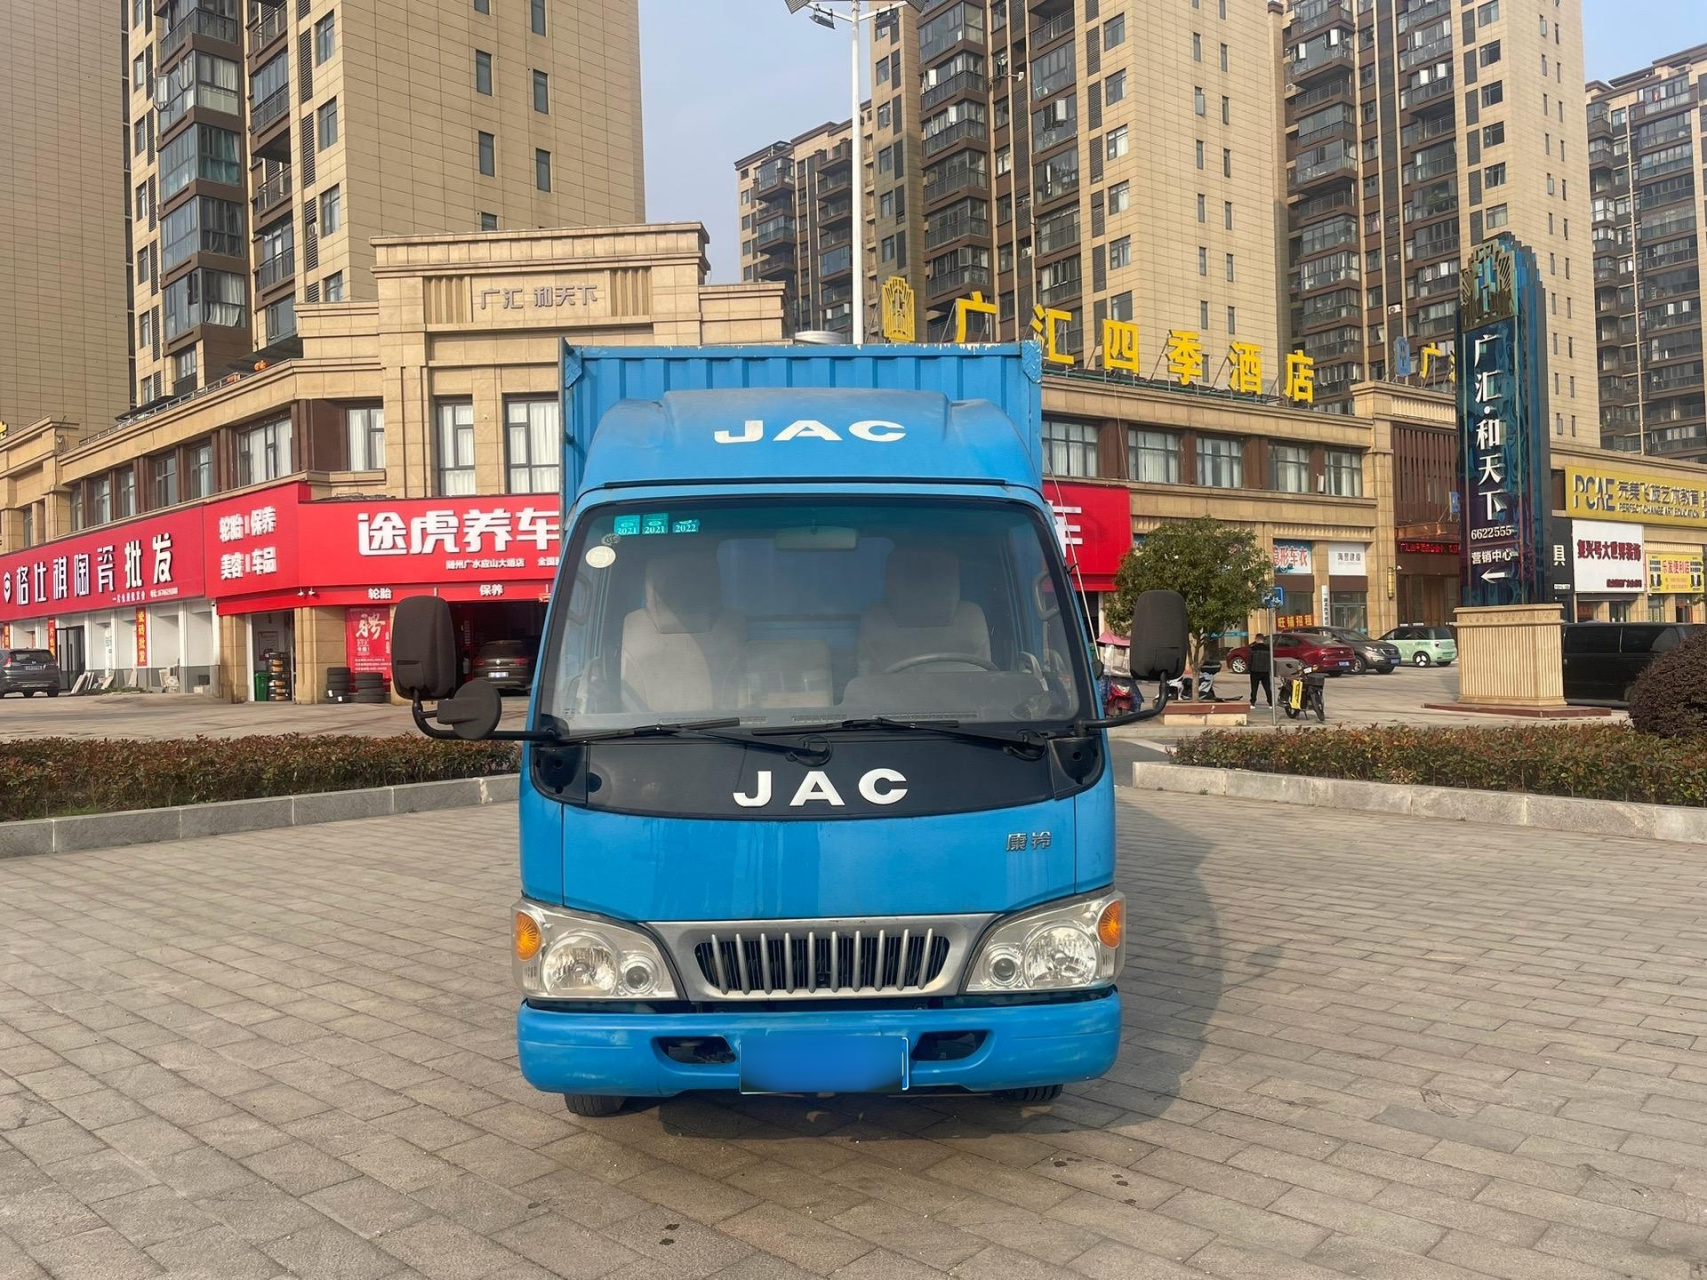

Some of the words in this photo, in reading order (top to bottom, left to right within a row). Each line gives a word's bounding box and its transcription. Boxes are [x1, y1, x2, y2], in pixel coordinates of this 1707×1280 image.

[955, 291, 1314, 403] 广汇四季酒店
[714, 419, 907, 444] JAC
[1573, 474, 1616, 511] PCAE
[357, 507, 560, 556] 途虎养车
[618, 527, 638, 535] 2021
[645, 526, 666, 534] 2021
[675, 524, 697, 533] 2022
[1471, 525, 1512, 540] 6622555
[1471, 548, 1512, 565] 营销中心
[1553, 544, 1565, 566] 具
[16, 532, 173, 606] 格仕祺陶瓷批发
[368, 587, 392, 600] 轮胎
[479, 584, 503, 597] 保养
[733, 768, 908, 807] JAC
[1006, 831, 1052, 851] 康铃
